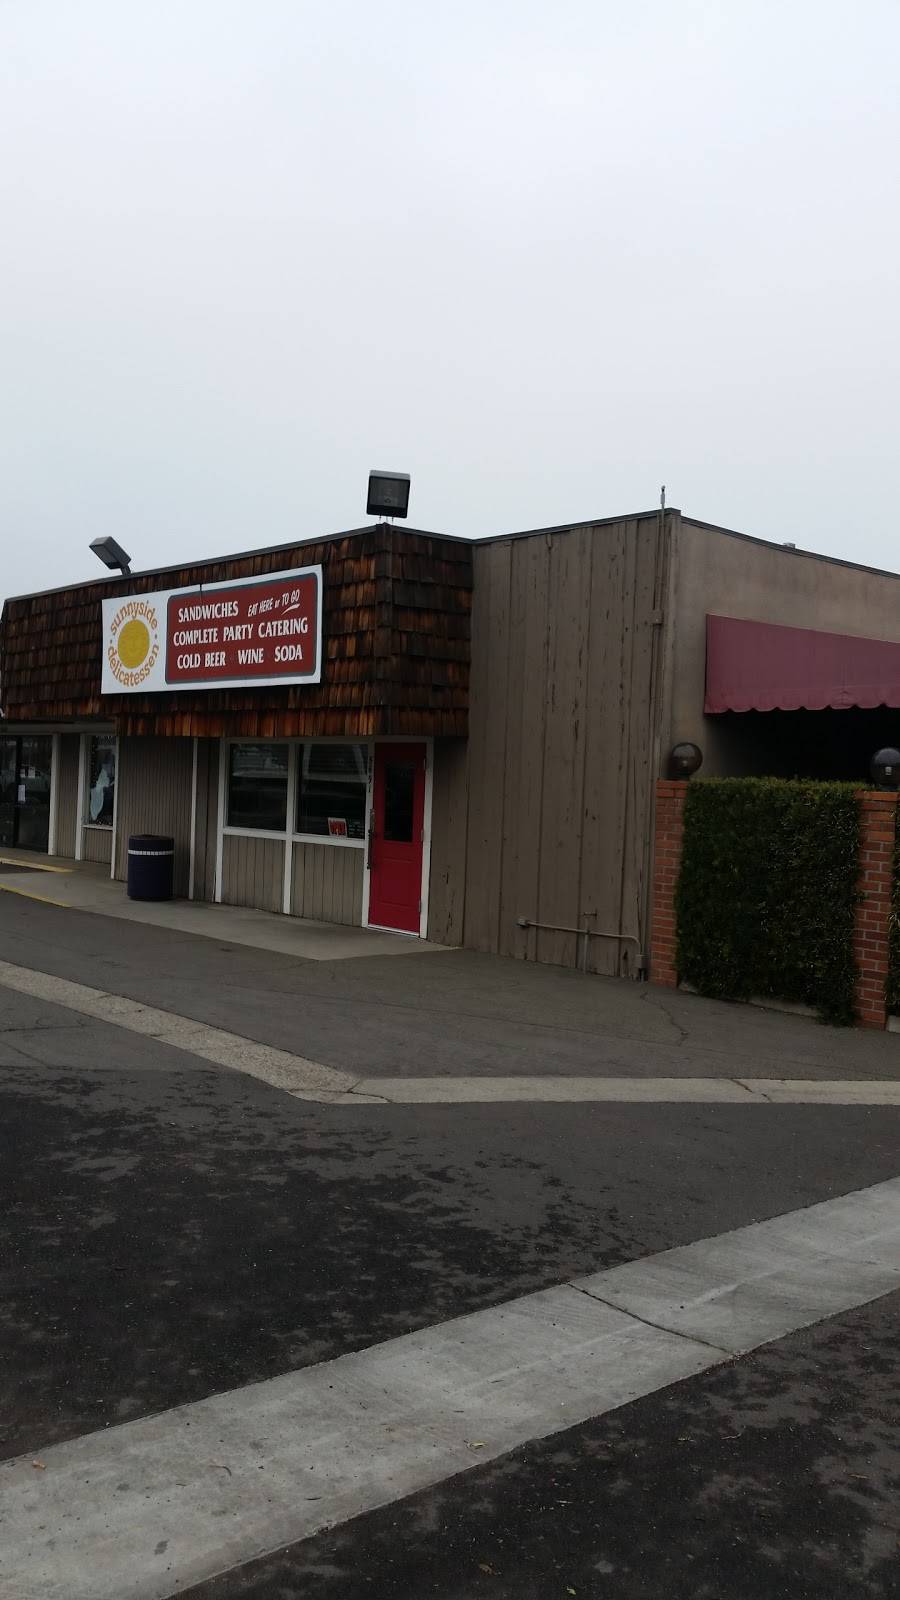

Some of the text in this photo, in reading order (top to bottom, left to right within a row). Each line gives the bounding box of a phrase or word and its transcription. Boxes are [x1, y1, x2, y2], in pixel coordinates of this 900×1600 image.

[110, 600, 158, 634] sunnyside
[178, 601, 239, 623] SANDWICHES
[247, 603, 259, 617] EAT
[259, 598, 274, 613] HERE
[281, 593, 290, 607] TO
[290, 589, 300, 602] GO
[173, 617, 308, 646] COMPLETE PARTY CATERING
[107, 645, 160, 688] delicatessen
[177, 644, 303, 669] COLD BEER WINE SODA
